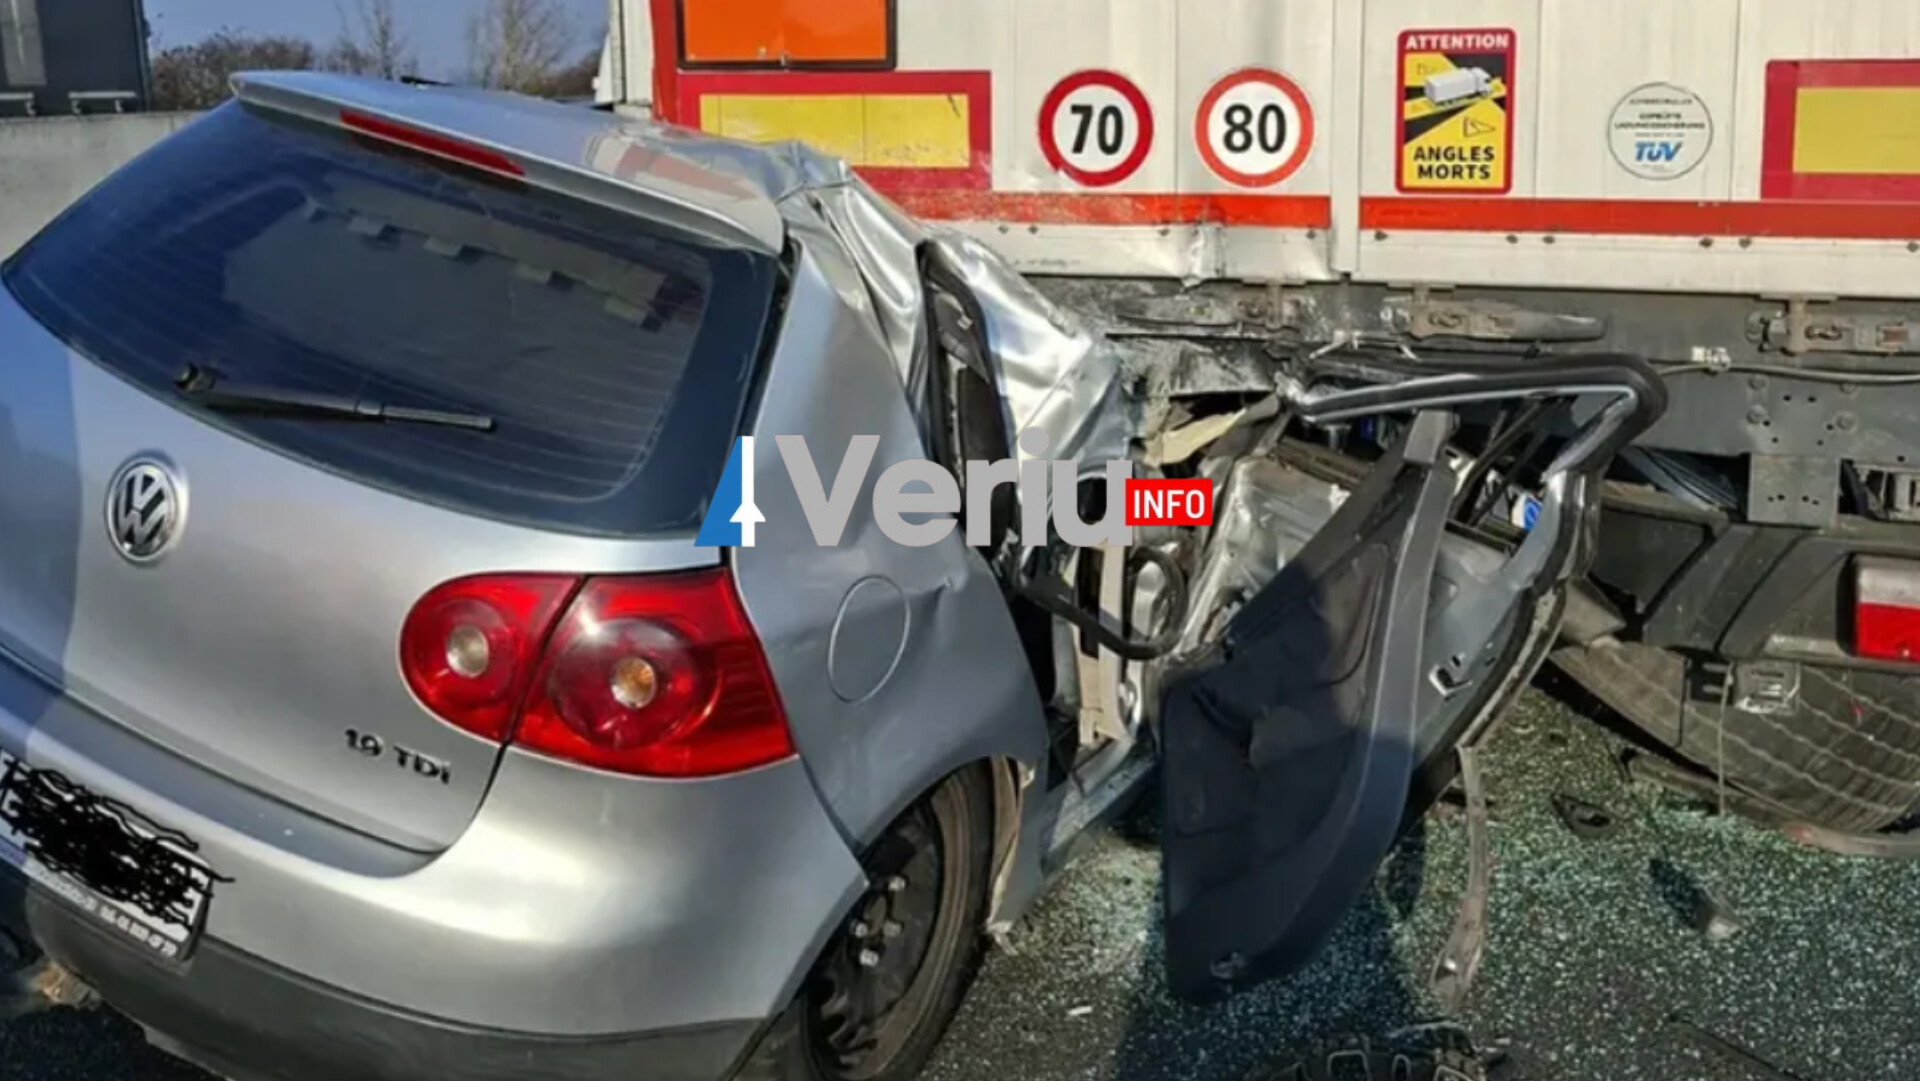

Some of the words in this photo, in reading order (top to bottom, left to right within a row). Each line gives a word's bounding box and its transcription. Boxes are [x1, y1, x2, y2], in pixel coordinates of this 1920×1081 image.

[1405, 33, 1509, 49] ATTENTION
[1070, 104, 1124, 155] 70
[1223, 103, 1287, 154] 80
[1413, 146, 1495, 162] ANGLES
[1417, 164, 1491, 180] MORTS
